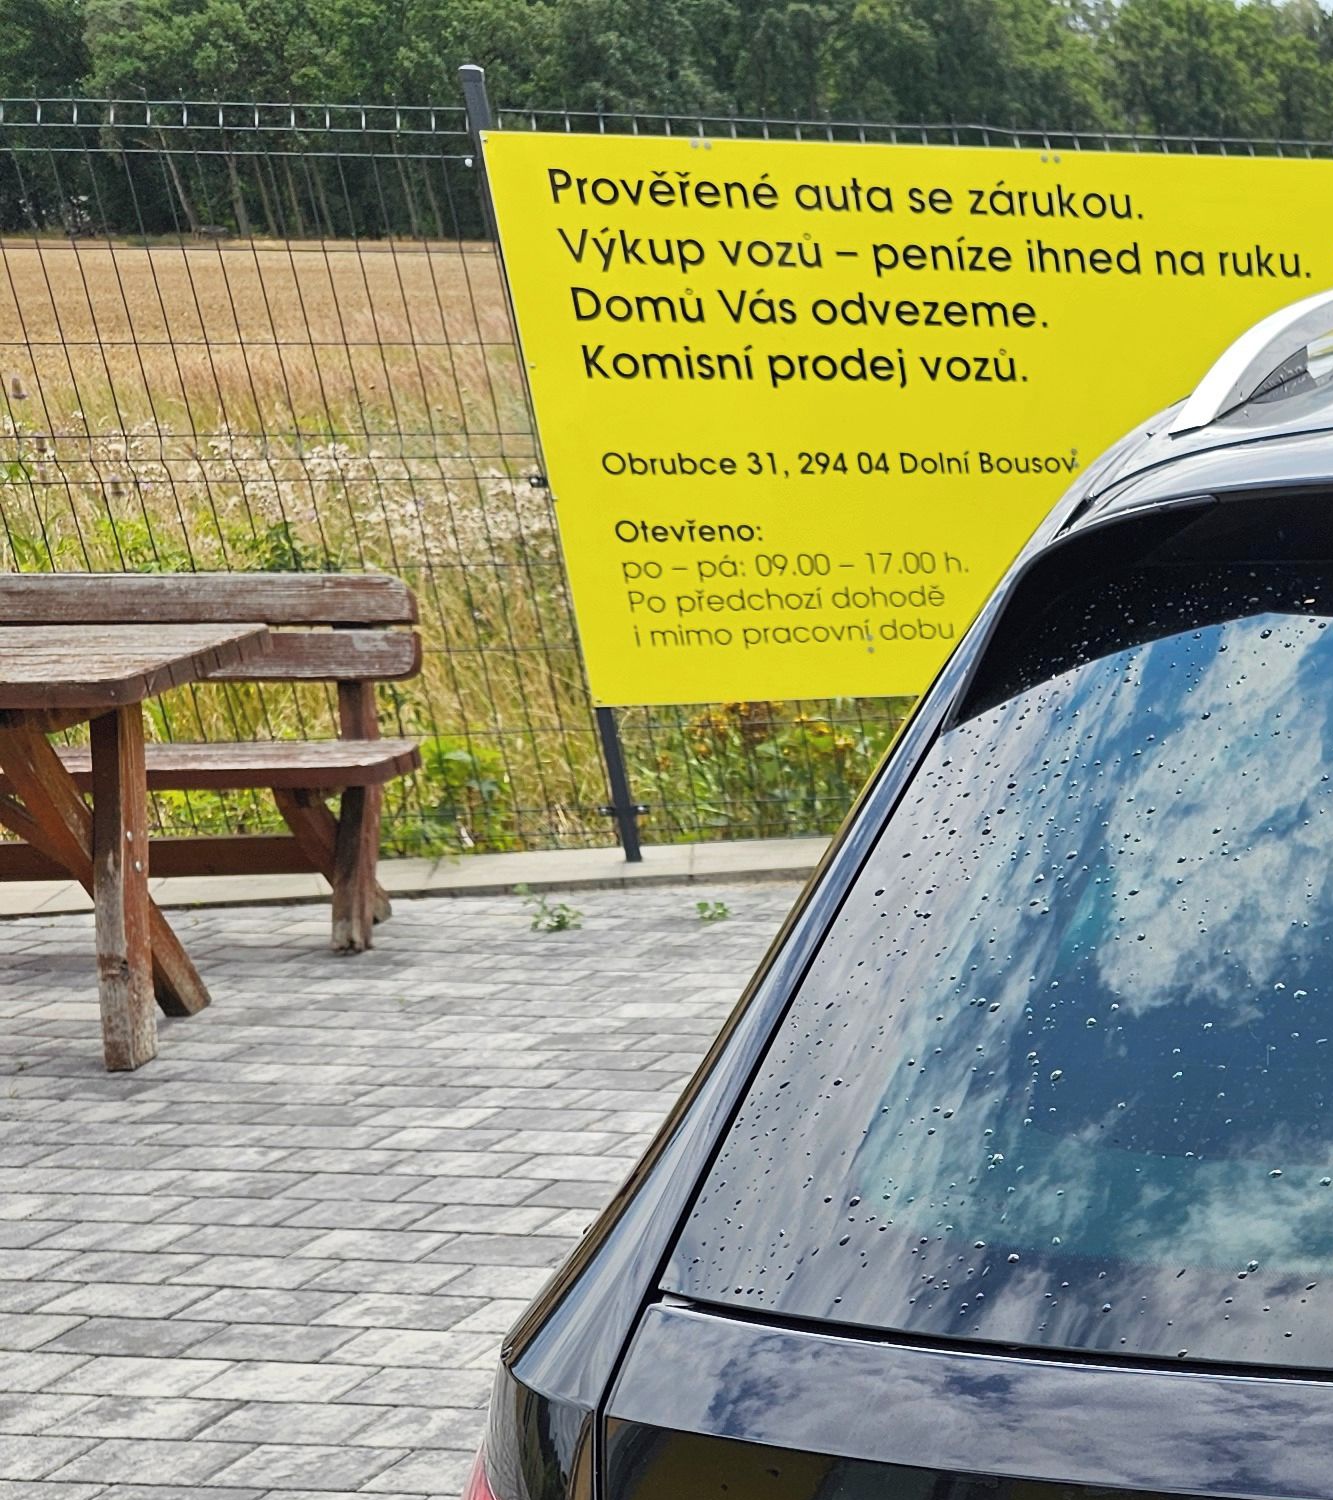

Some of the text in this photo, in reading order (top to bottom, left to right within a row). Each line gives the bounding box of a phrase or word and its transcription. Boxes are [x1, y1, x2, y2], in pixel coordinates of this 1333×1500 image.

[547, 168, 1143, 220] Prověřené auta se zárukou.
[556, 226, 705, 274] Výkup
[718, 233, 823, 269] vozů
[872, 235, 1012, 278] peníze
[1026, 239, 1141, 275] ihned
[1155, 249, 1205, 277] na
[1218, 244, 1311, 279] ruku.
[570, 286, 1048, 329] Domů Vás odvezeme.
[581, 344, 1028, 389] Komisní prodej vozů.
[601, 450, 1075, 479] Obrubce 31, 294 04 Dolní Bousov
[614, 519, 763, 544] Otevřeno:
[621, 561, 663, 583] po
[697, 554, 746, 582] pá:
[755, 553, 831, 577] 09.00
[865, 551, 936, 575] 17.00
[944, 552, 969, 572] h.
[627, 585, 945, 617] Po předchozí dohodě
[633, 619, 955, 648] i mimo pracovní dobu
